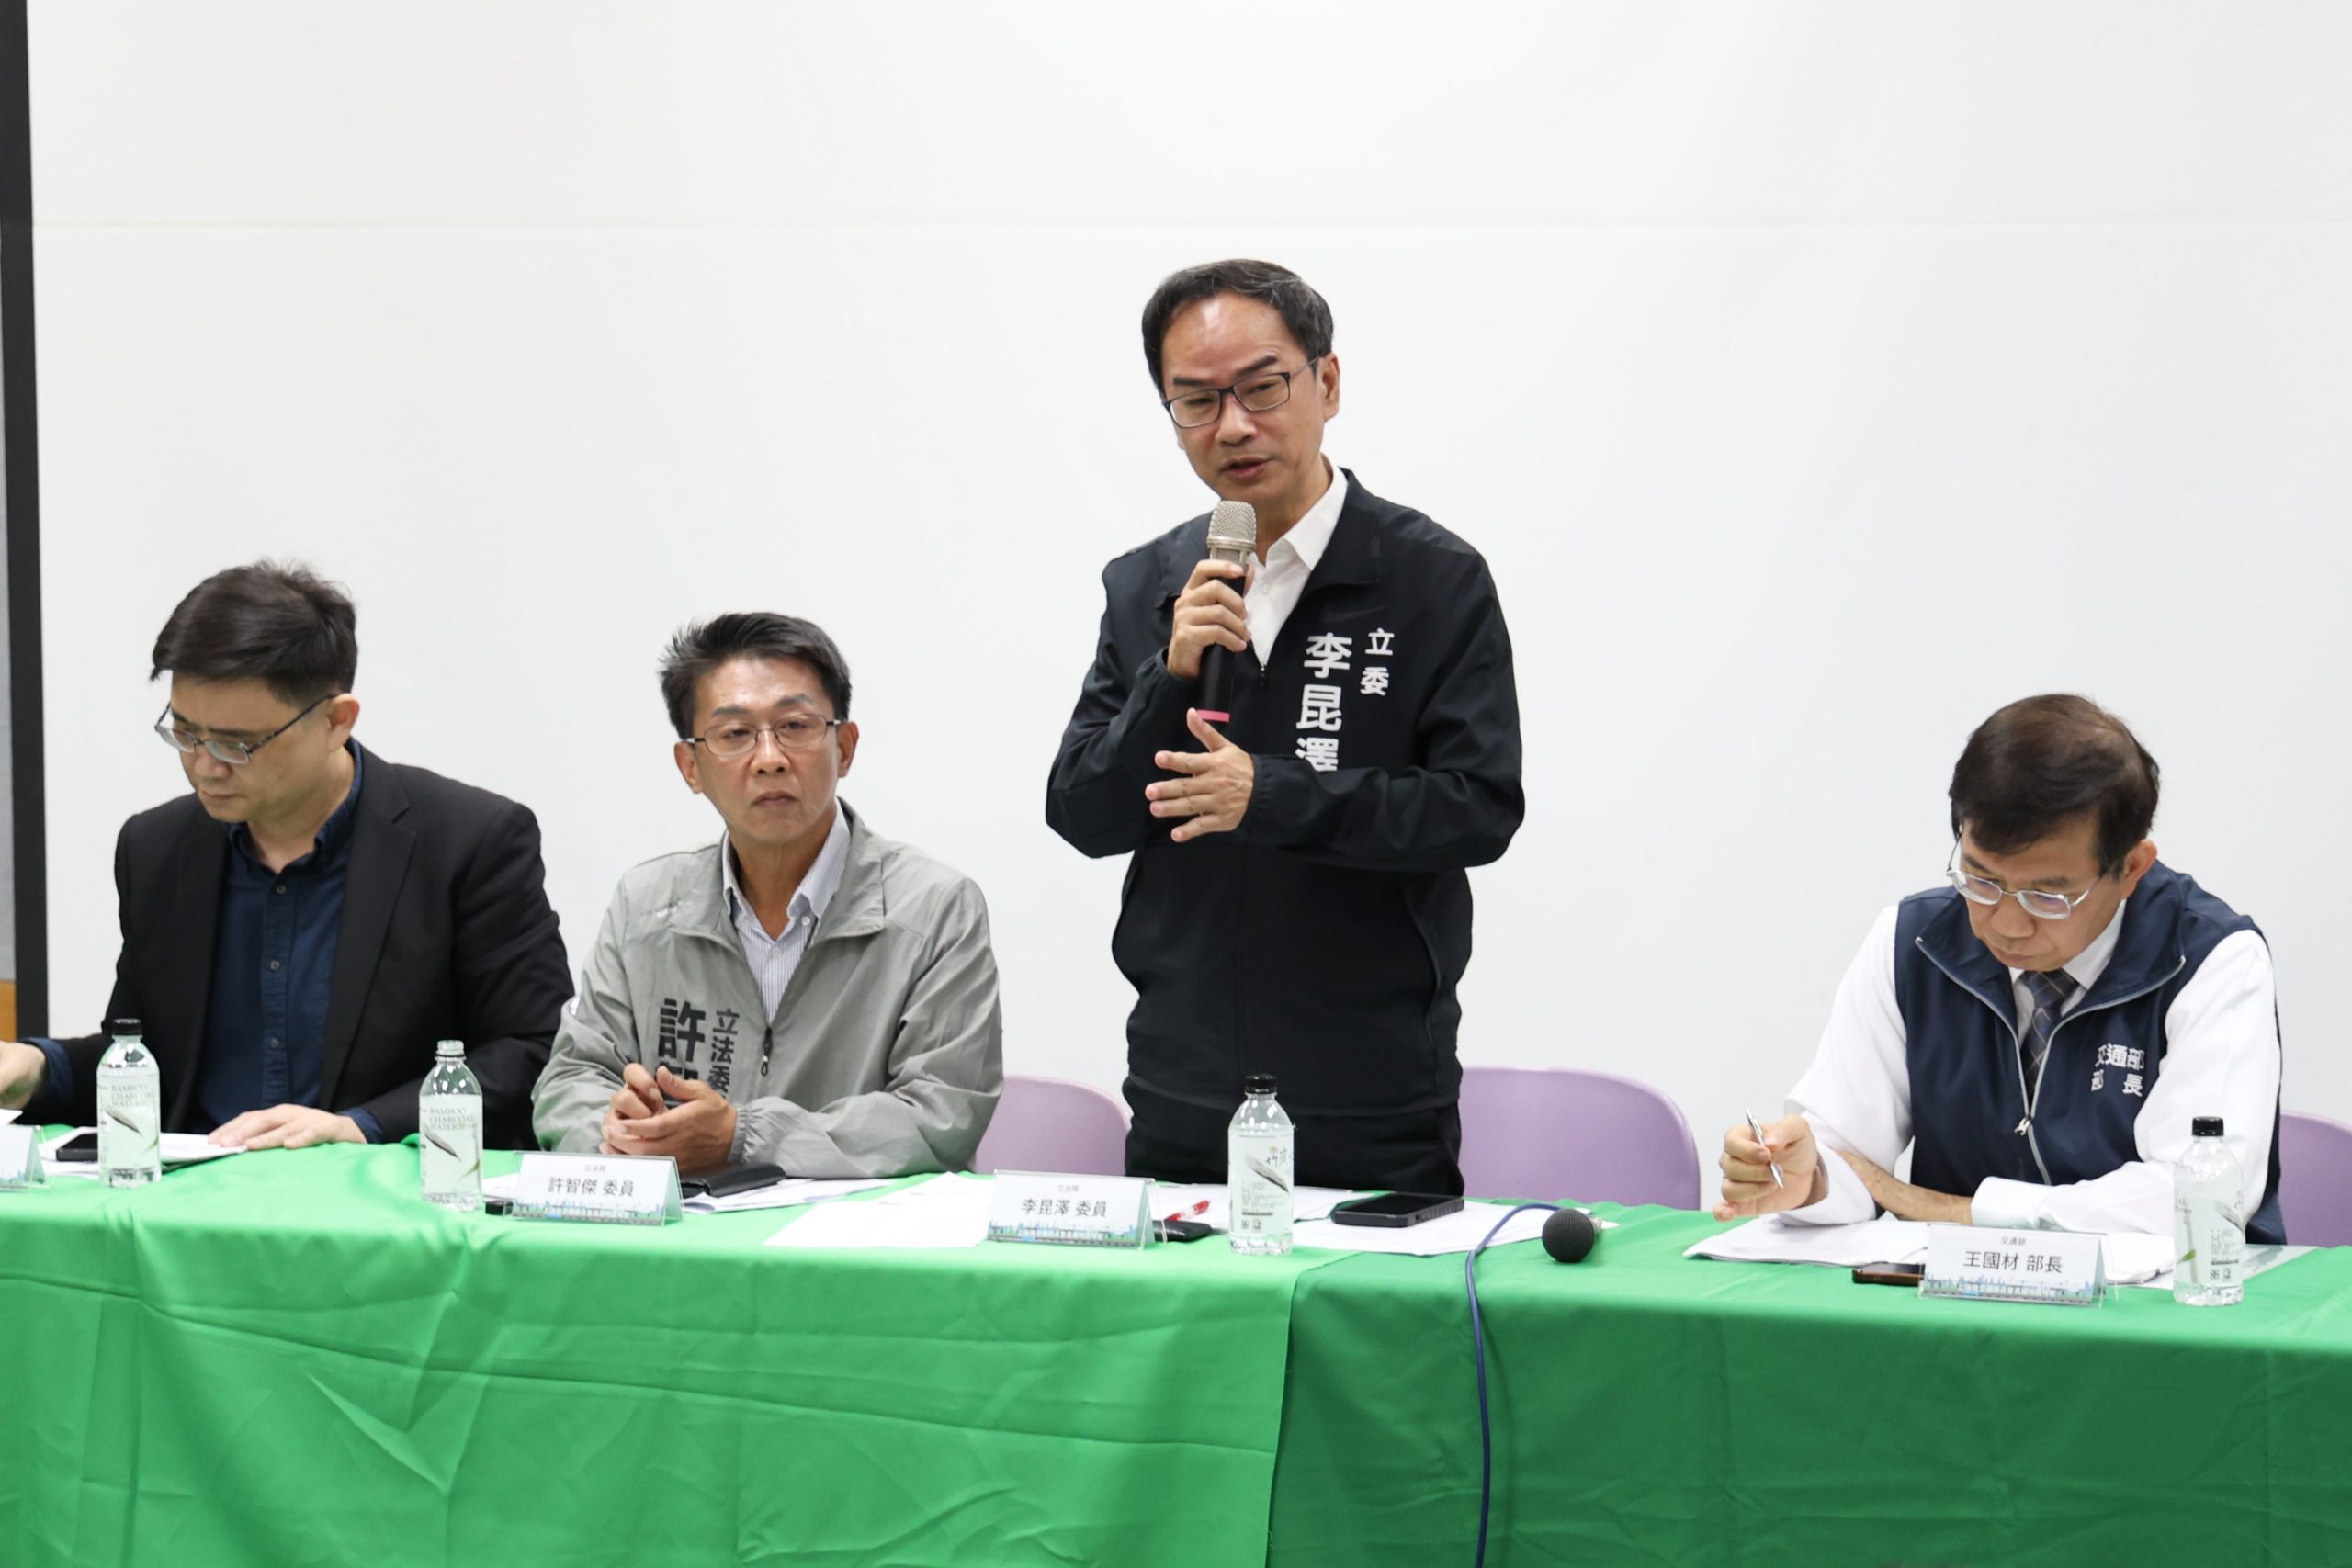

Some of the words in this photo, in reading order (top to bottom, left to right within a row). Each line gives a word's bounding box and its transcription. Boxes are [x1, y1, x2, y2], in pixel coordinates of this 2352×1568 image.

[1360, 627, 1395, 696] 立委
[707, 1008, 740, 1099] 立法委
[2095, 1043, 2144, 1071] 交通部
[548, 1177, 597, 1195] 許智傑
[602, 1179, 634, 1198] 委員
[1022, 1198, 1070, 1216] 李昆澤
[1075, 1201, 1107, 1218] 委員
[1963, 1250, 2021, 1271] 王國材
[2026, 1254, 2064, 1274] 部長
